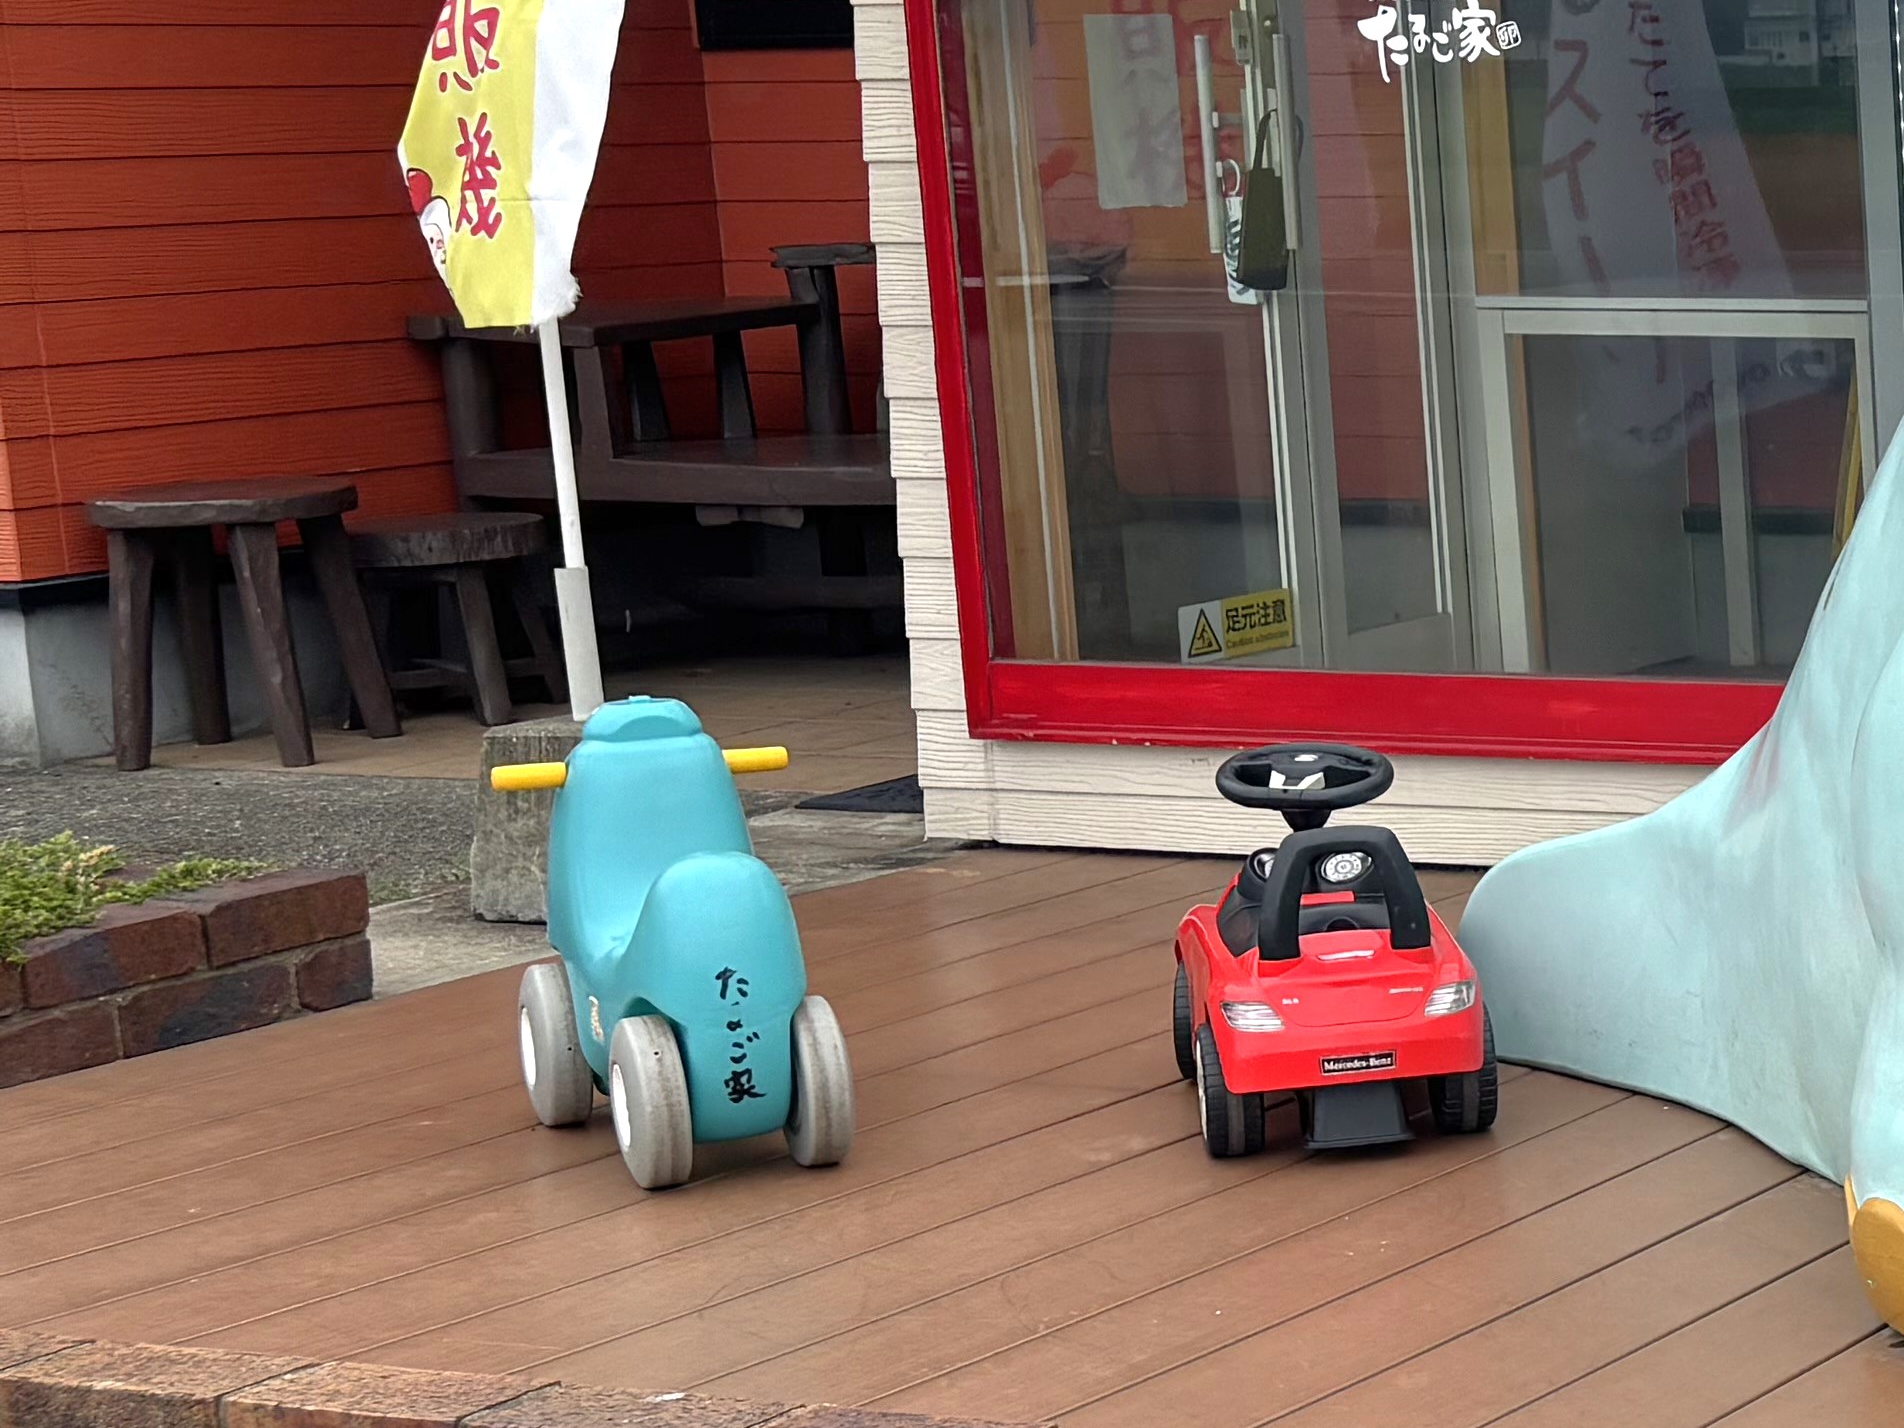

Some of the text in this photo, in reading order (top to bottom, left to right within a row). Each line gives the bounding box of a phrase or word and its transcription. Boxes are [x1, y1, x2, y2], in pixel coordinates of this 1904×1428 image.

[1225, 598, 1287, 634] 足元注意
[1323, 1056, 1392, 1071] Mercedes-Benz
